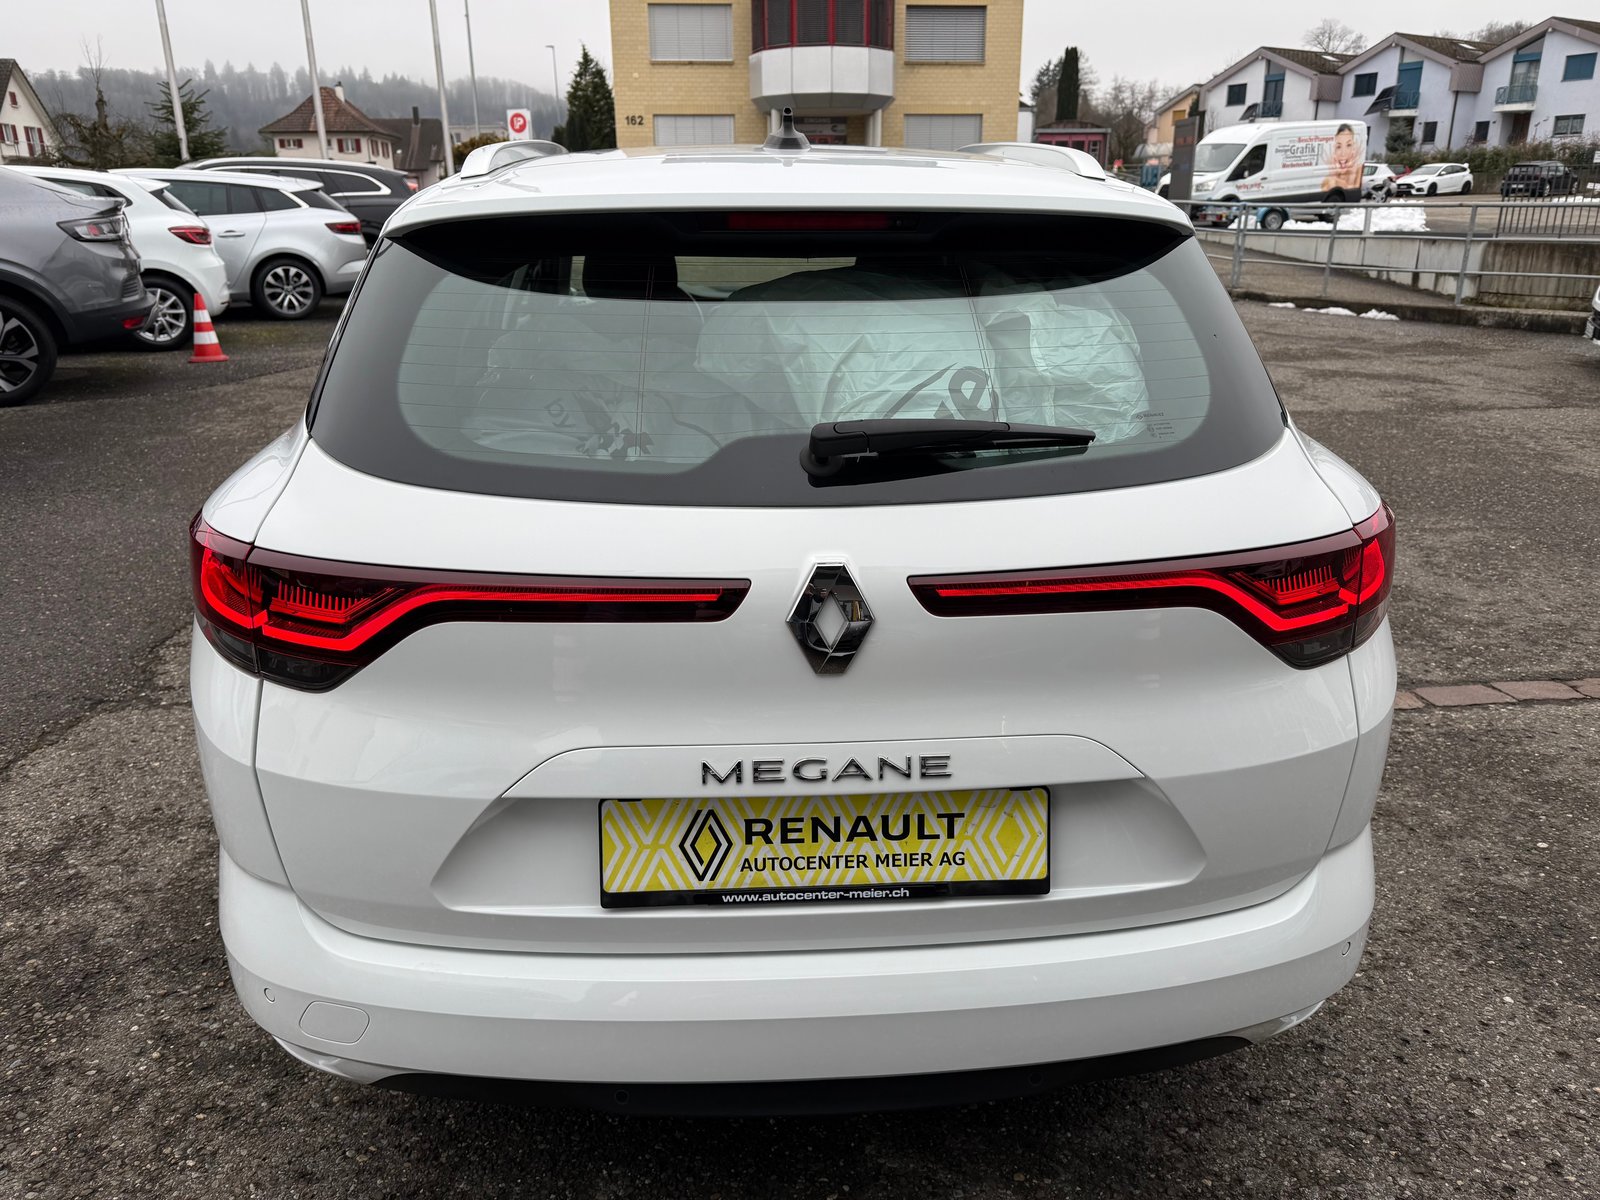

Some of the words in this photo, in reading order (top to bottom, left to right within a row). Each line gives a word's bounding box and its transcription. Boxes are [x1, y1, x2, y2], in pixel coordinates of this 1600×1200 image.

[625, 115, 645, 126] 162
[1290, 143, 1317, 155] Grafik
[700, 753, 953, 785] MEGANE
[743, 812, 966, 846] RENAULT
[740, 854, 869, 873] AUTOCENTER
[875, 852, 933, 868] MEIER
[939, 851, 966, 866] AG
[721, 887, 910, 903] www.autocenter-meier.ch
